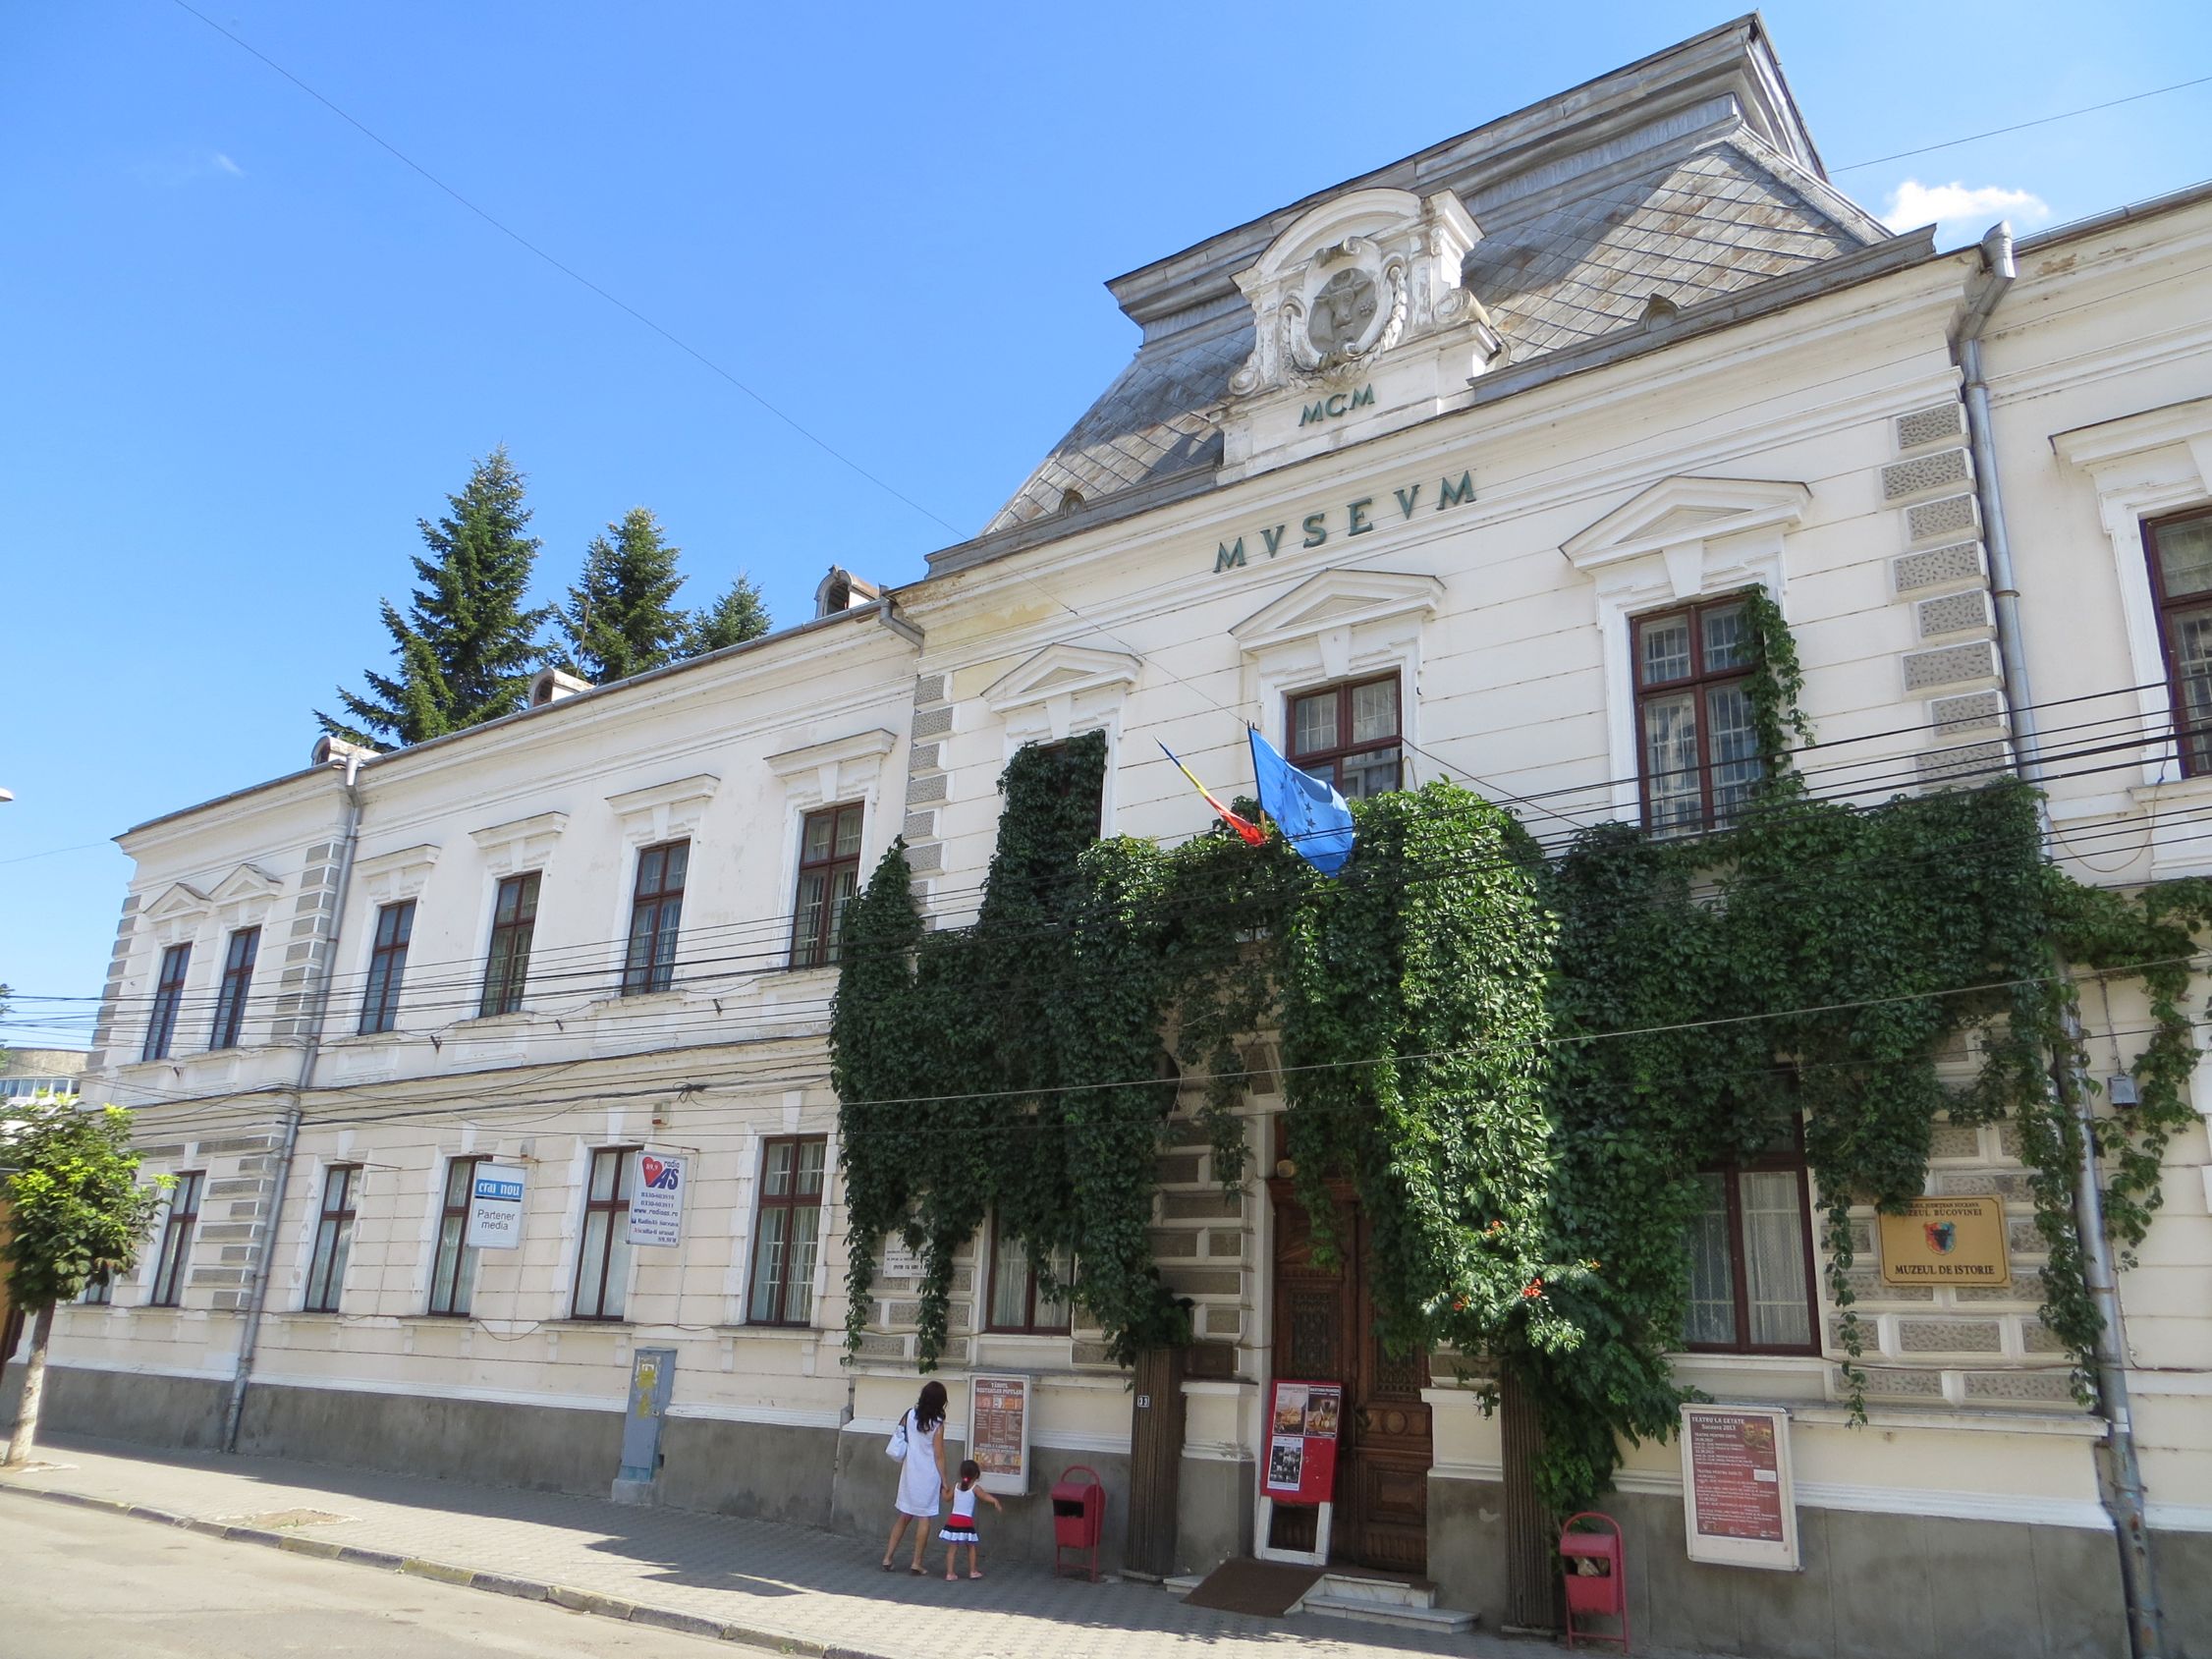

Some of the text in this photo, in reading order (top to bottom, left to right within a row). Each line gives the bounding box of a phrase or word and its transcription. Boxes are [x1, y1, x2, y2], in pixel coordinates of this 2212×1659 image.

[1298, 383, 1375, 428] MCM
[1213, 470, 1476, 574] MVSEVM
[664, 1160, 680, 1168] radio
[648, 1168, 679, 1190] AS
[478, 1182, 520, 1196] crai nou
[477, 1209, 515, 1220] Partener
[1934, 1208, 1982, 1217] BUCOVINEI
[481, 1221, 508, 1230] media
[1895, 1265, 1995, 1275] MUZEUL DE ISTORIE
